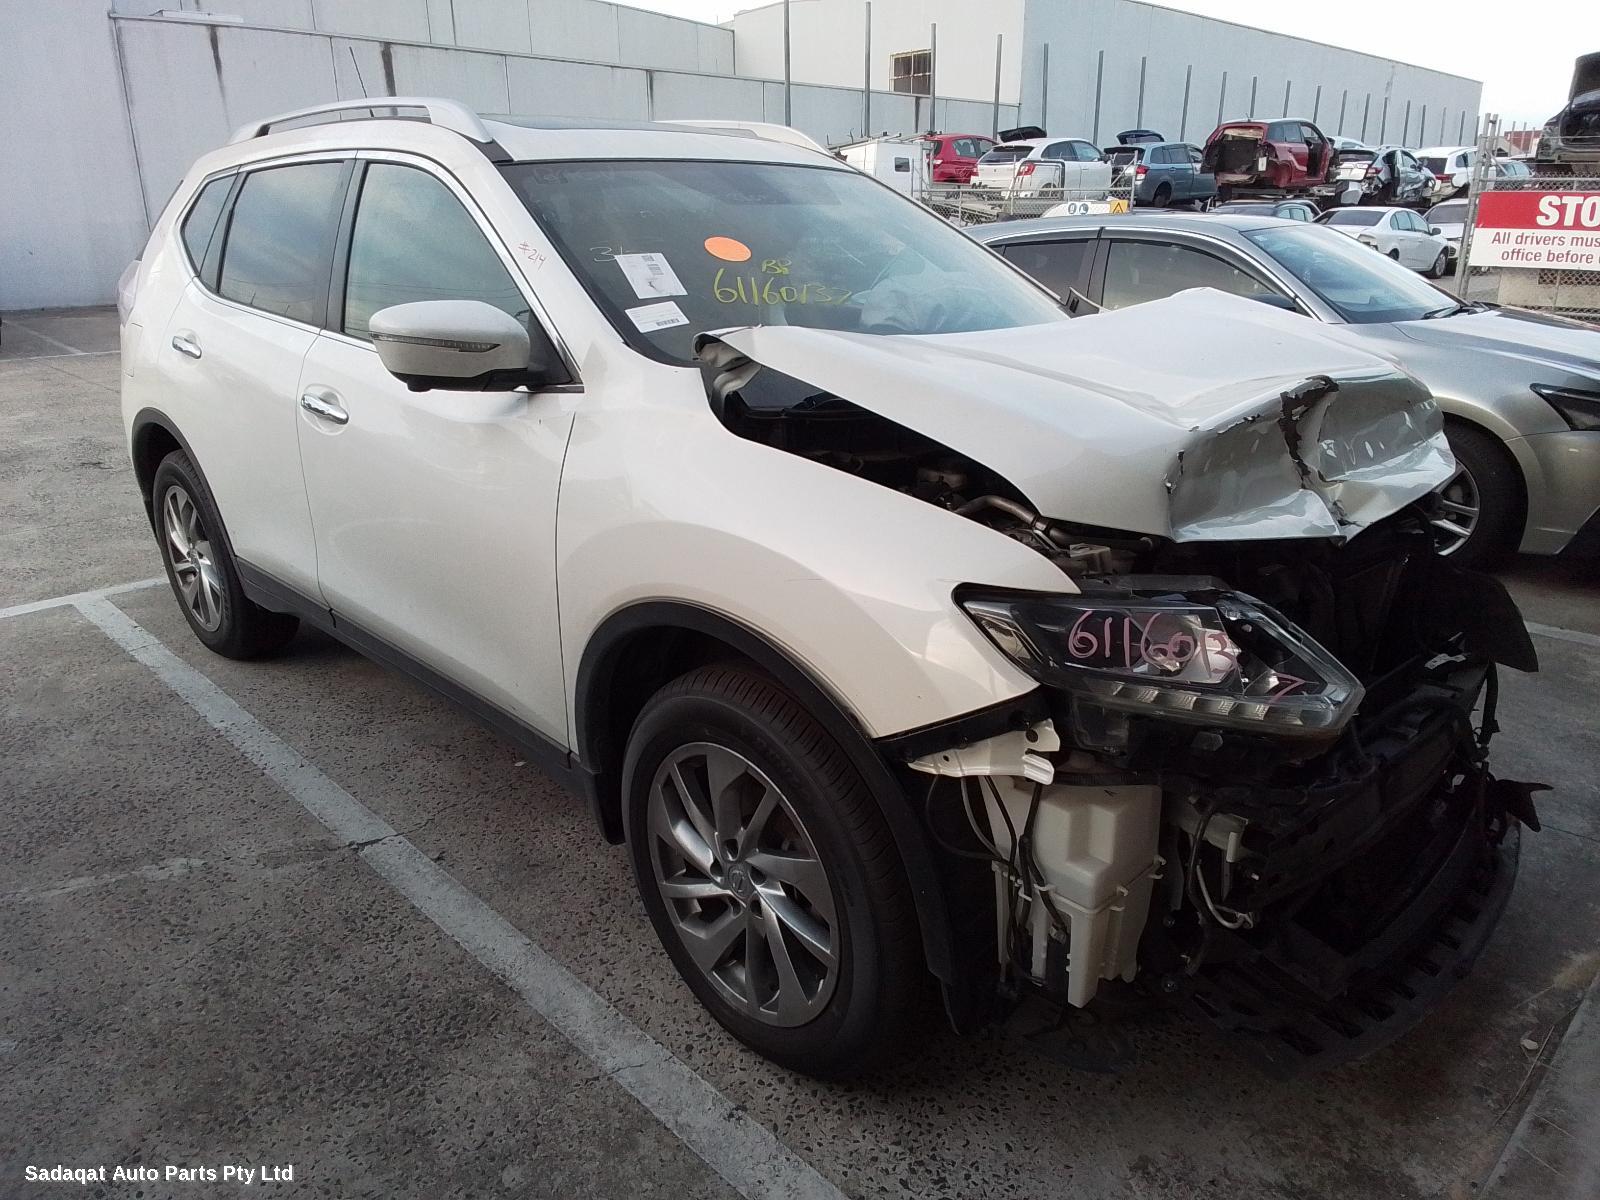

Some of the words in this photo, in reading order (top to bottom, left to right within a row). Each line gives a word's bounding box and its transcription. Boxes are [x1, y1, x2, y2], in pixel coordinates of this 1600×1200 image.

[1536, 195, 1600, 228] STO
[1491, 231, 1511, 245] All
[1515, 232, 1566, 246] drivers
[1501, 248, 1541, 262] office
[1546, 249, 1594, 264] before
[713, 268, 852, 305] 61160137
